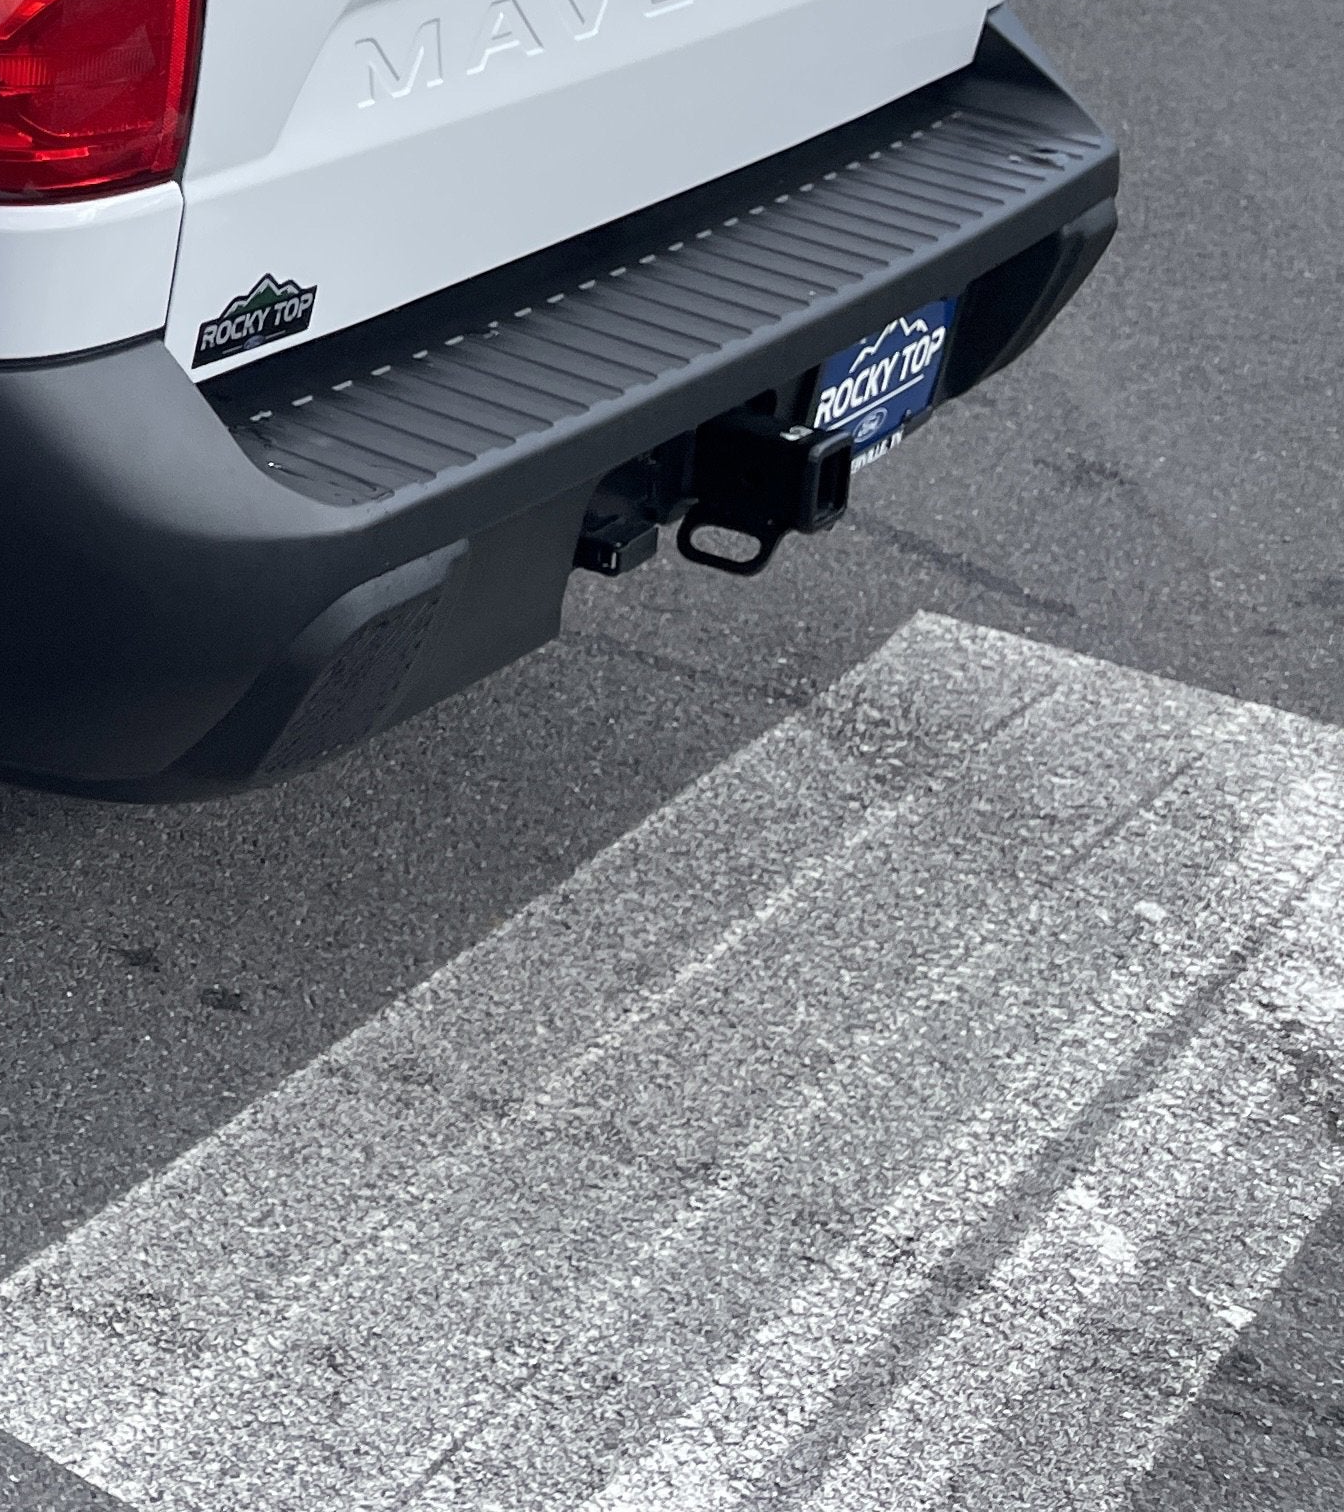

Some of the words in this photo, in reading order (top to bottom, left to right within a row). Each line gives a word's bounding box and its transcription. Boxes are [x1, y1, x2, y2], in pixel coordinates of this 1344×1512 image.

[200, 306, 272, 352] ROCKY
[273, 292, 313, 327] TOP
[813, 350, 902, 429] ROCKY
[898, 325, 947, 382] TOP
